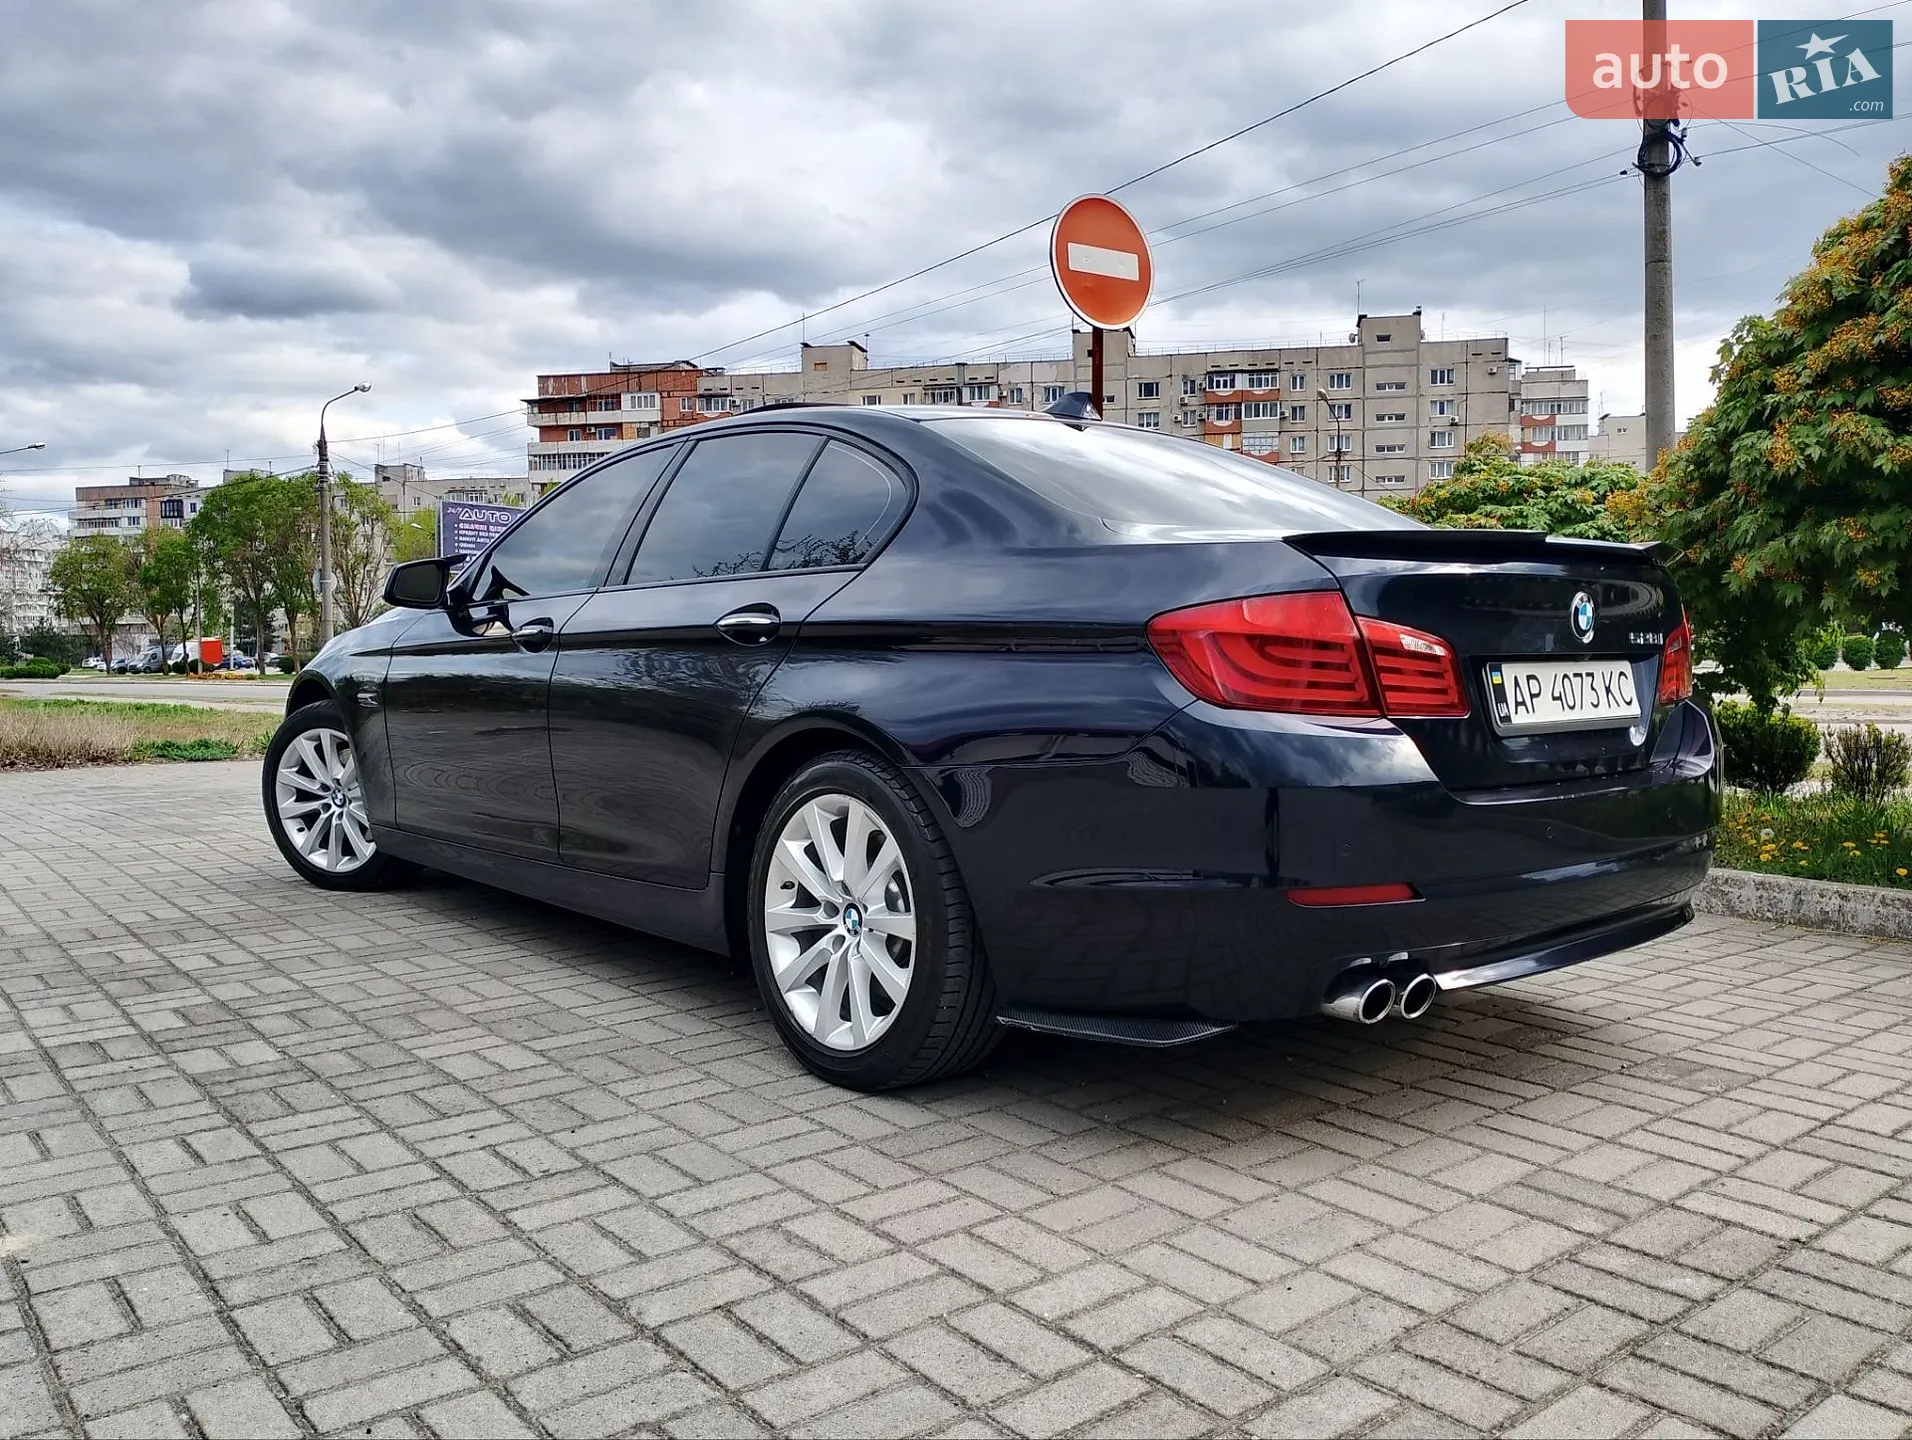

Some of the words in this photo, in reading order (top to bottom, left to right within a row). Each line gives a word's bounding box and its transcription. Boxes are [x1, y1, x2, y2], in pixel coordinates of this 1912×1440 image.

[459, 508, 512, 524] AUTO
[1512, 674, 1542, 715] AP
[1551, 672, 1600, 712] 4073
[1602, 670, 1633, 709] KC
[1497, 702, 1510, 717] UA
